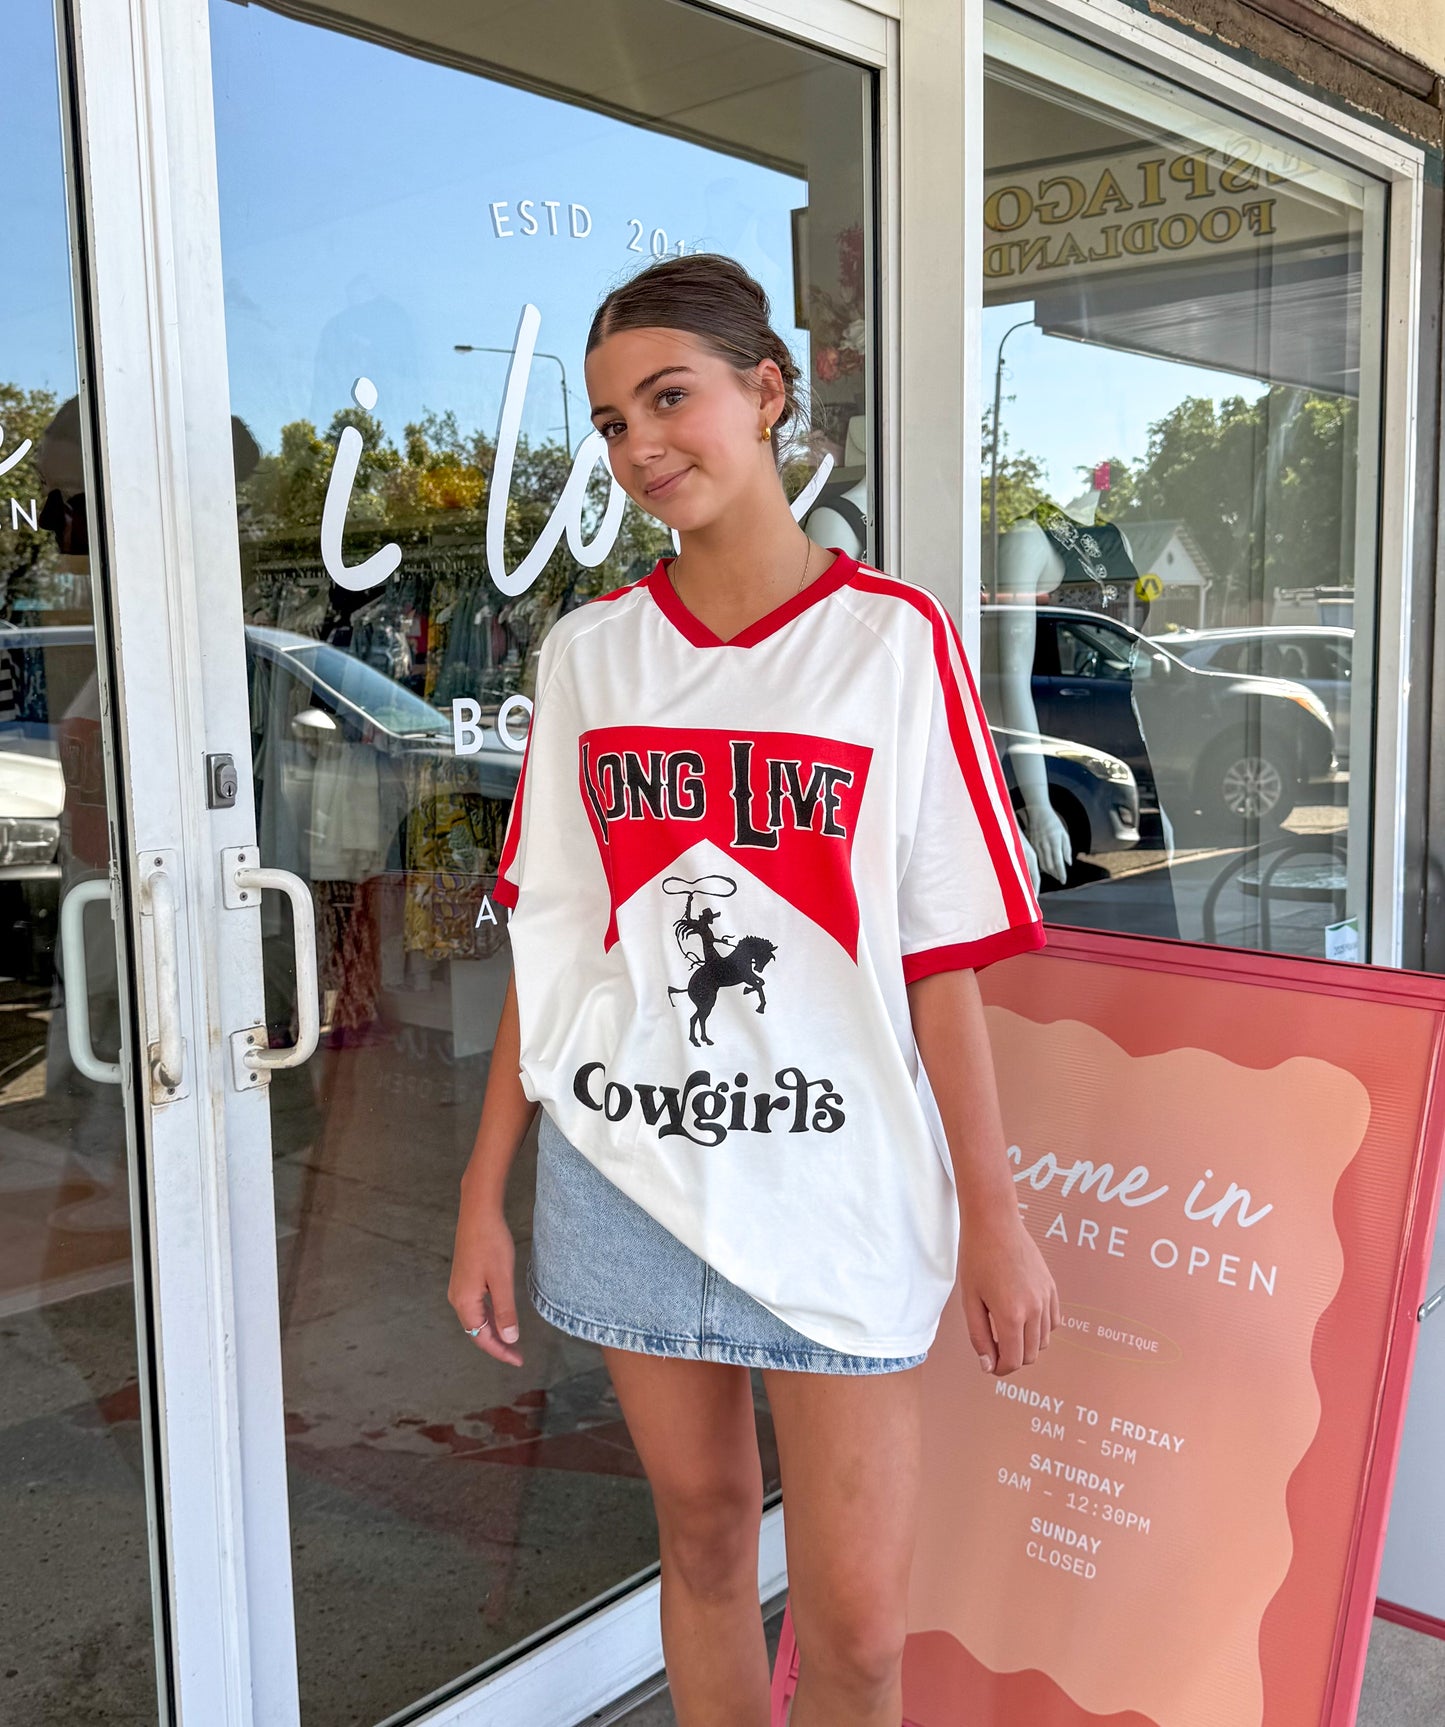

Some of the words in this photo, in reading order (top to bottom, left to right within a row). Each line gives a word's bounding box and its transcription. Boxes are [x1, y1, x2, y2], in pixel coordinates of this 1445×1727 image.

[491, 199, 593, 238] ESTD
[628, 218, 705, 259] 201
[573, 1061, 846, 1147] Cowgirls
[1184, 1169, 1273, 1228] in
[1045, 1213, 1129, 1257] ARE
[1150, 1239, 1277, 1297] OPEN
[1061, 1315, 1090, 1332] LOVE
[1097, 1326, 1159, 1353] BOUTIQUE
[995, 1380, 1064, 1414] MONDAY
[1076, 1405, 1098, 1426] TO
[1110, 1417, 1185, 1453] FRDIAY
[1031, 1416, 1065, 1441] 9AM
[1100, 1439, 1137, 1465] 5PM
[997, 1467, 1031, 1493] 9AM
[1066, 1493, 1151, 1535] 12:30PM
[1029, 1453, 1125, 1498] SATURDAY
[1026, 1541, 1097, 1580] CLOSED
[1030, 1516, 1101, 1555] SUNDAY
